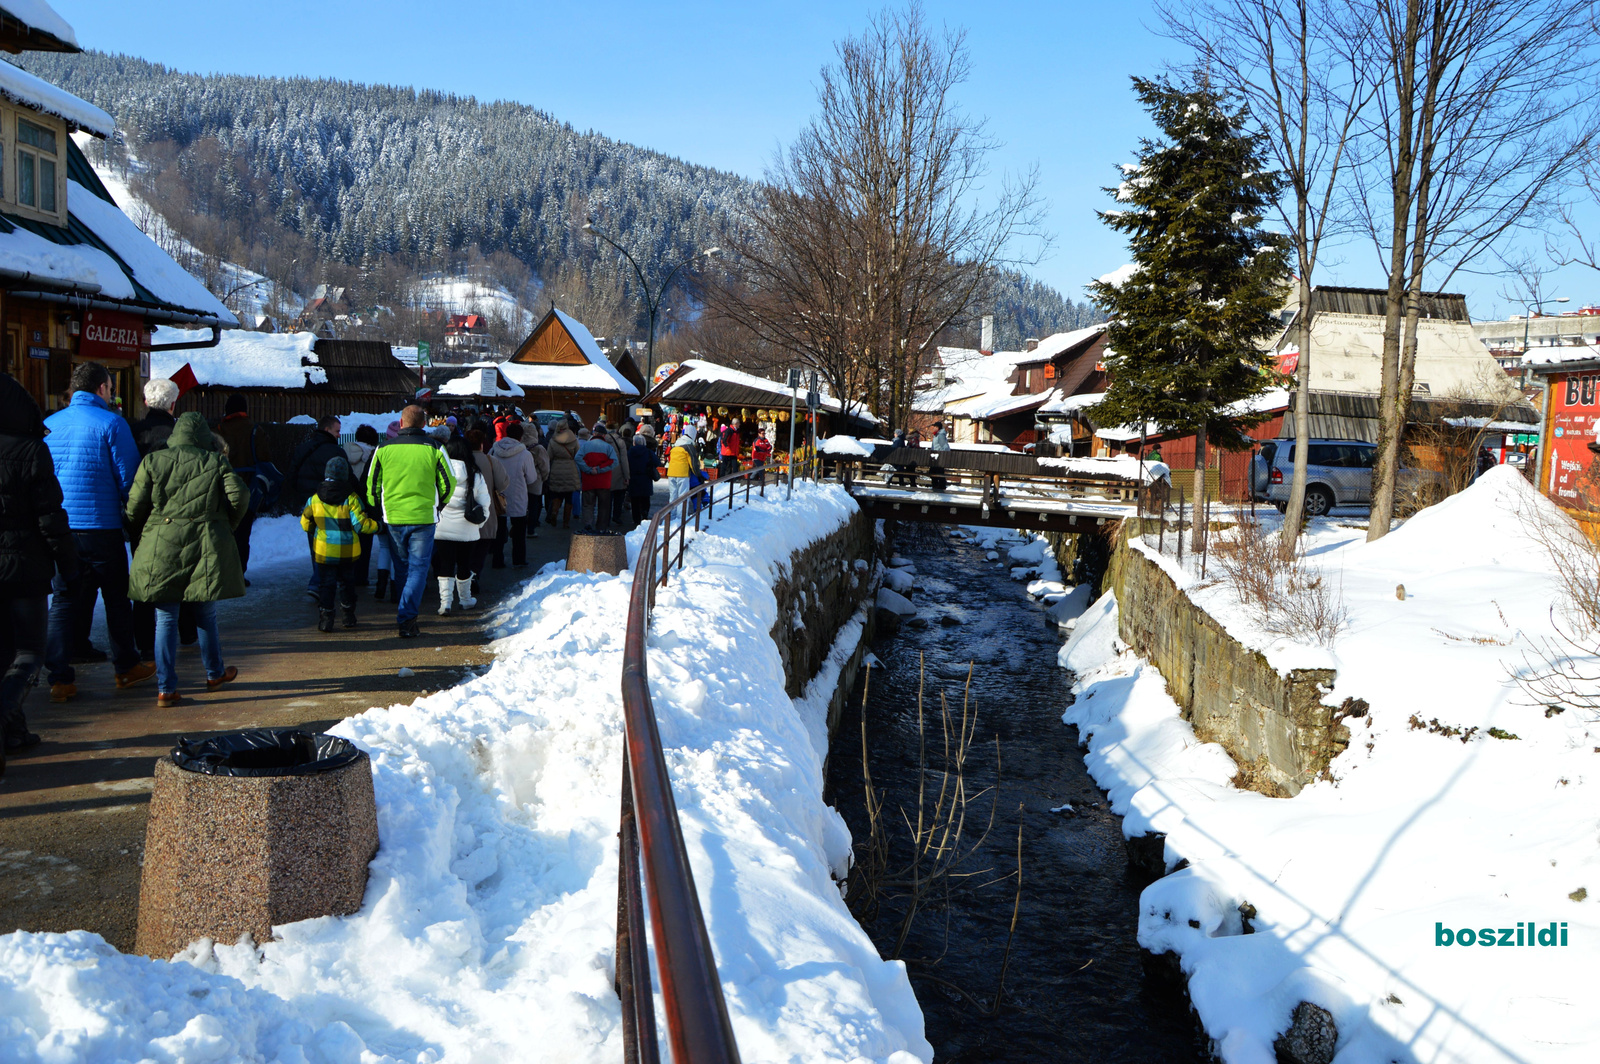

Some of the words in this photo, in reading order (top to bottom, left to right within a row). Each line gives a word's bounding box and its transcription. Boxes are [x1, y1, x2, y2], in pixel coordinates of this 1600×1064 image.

[86, 324, 139, 346] GALERIA
[1564, 375, 1600, 407] BU
[1559, 474, 1568, 483] od
